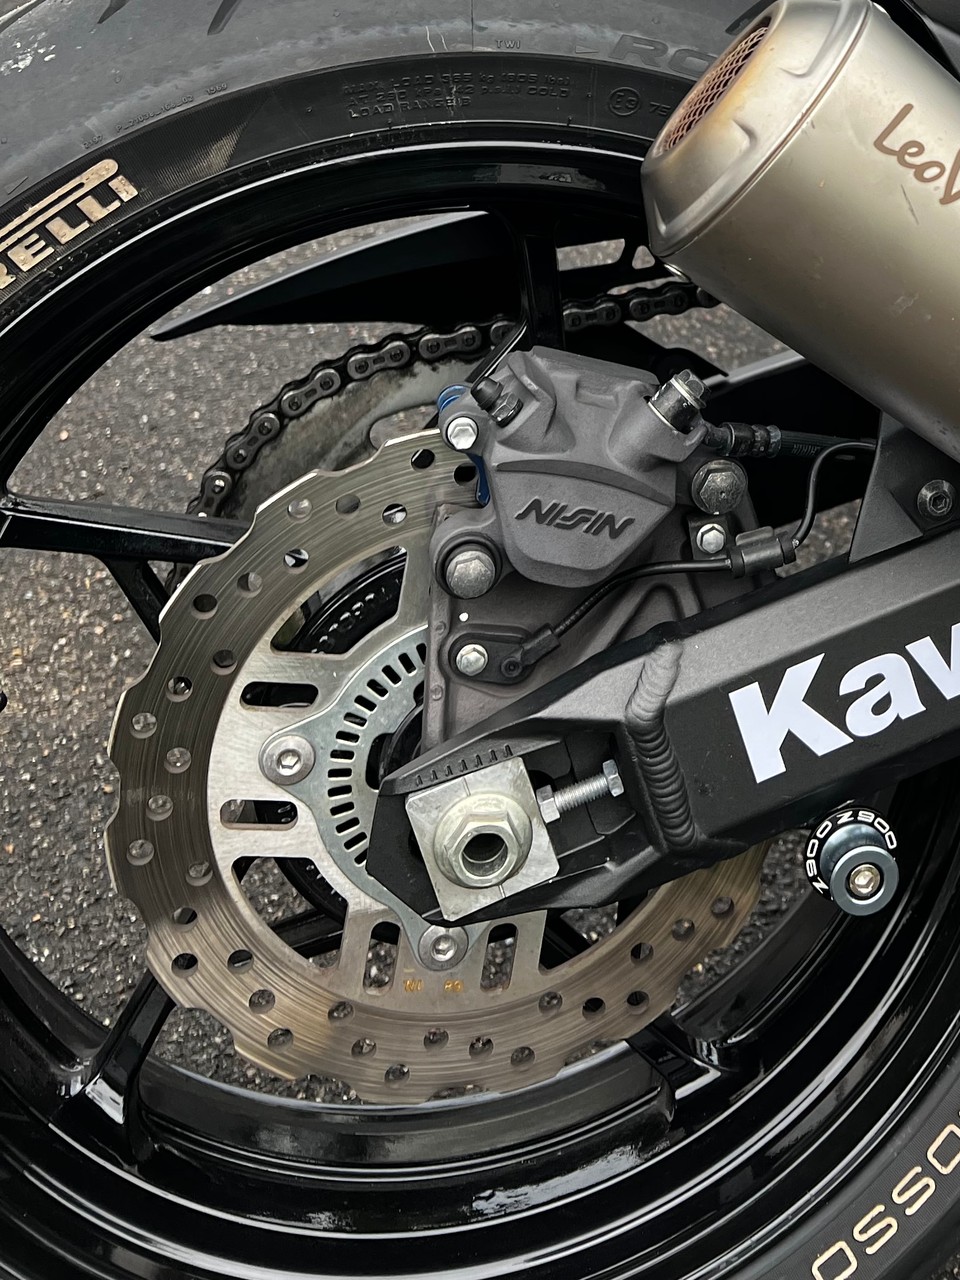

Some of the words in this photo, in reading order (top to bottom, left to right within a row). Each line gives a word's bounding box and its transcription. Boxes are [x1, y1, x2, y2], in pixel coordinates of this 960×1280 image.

[494, 38, 521, 50] TWI
[515, 496, 635, 539] NISSIN
[806, 820, 833, 894] Z900
[836, 810, 898, 850] Z900
